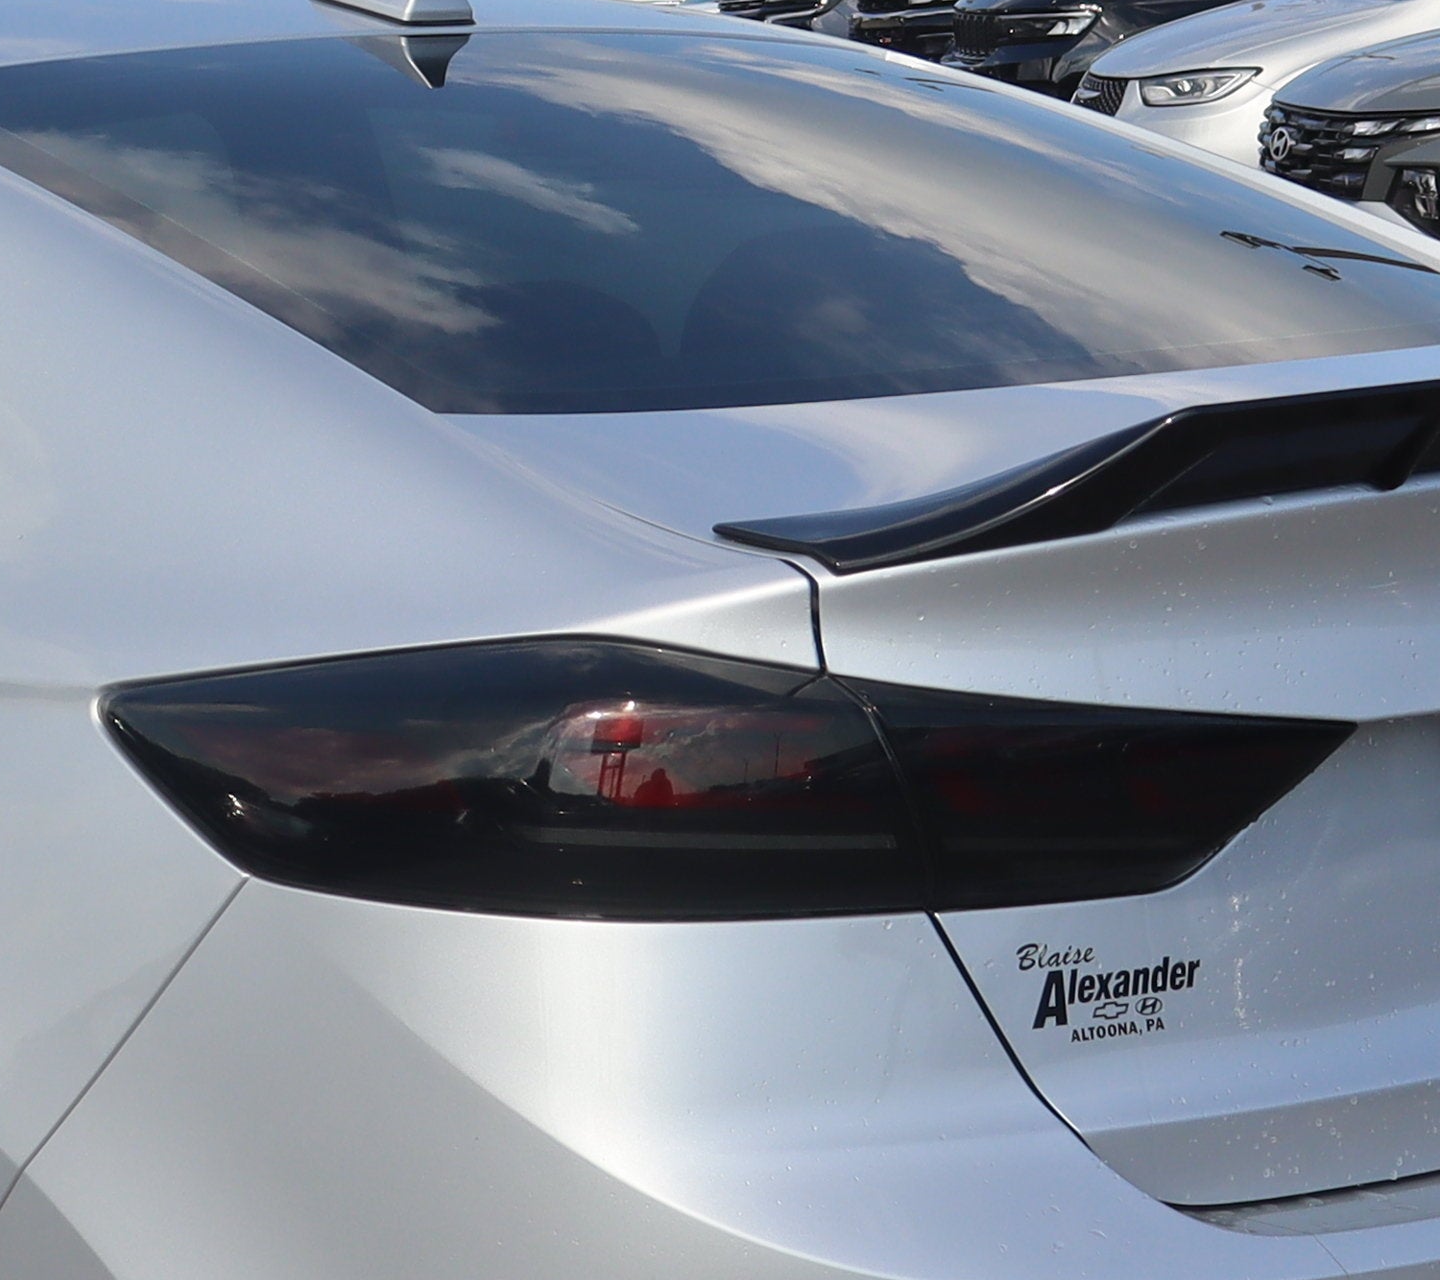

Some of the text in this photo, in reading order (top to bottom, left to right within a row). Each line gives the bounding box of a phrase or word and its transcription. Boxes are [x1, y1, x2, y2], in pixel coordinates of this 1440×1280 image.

[1016, 943, 1096, 971] Blaise
[1032, 956, 1201, 1030] Alexander
[1071, 1017, 1165, 1043] ALTOONA, PA
